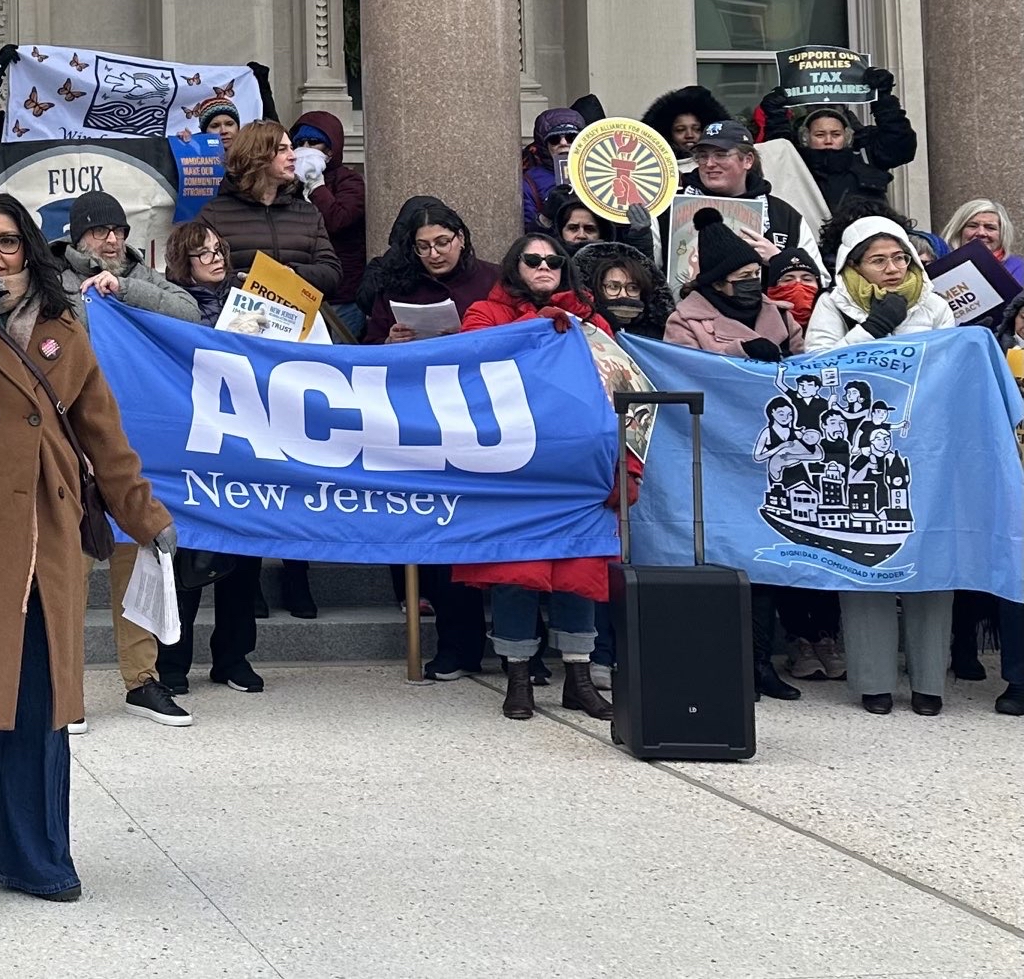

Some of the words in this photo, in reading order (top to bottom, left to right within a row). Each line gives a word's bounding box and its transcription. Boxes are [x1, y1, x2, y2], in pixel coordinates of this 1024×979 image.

[788, 51, 836, 63] SUPPORT
[839, 52, 861, 61] OUR
[799, 60, 851, 70] FAMILIES
[809, 72, 842, 82] TAX
[600, 123, 626, 131] ALLIANCE
[48, 166, 104, 194] FUCK
[271, 321, 292, 333] TRUST
[846, 356, 913, 373] JERSEY
[185, 348, 536, 473] ACLU
[181, 469, 290, 511] New
[304, 481, 463, 526] Jersey
[821, 557, 868, 578] COMUNIDAD
[877, 571, 905, 579] PODER
